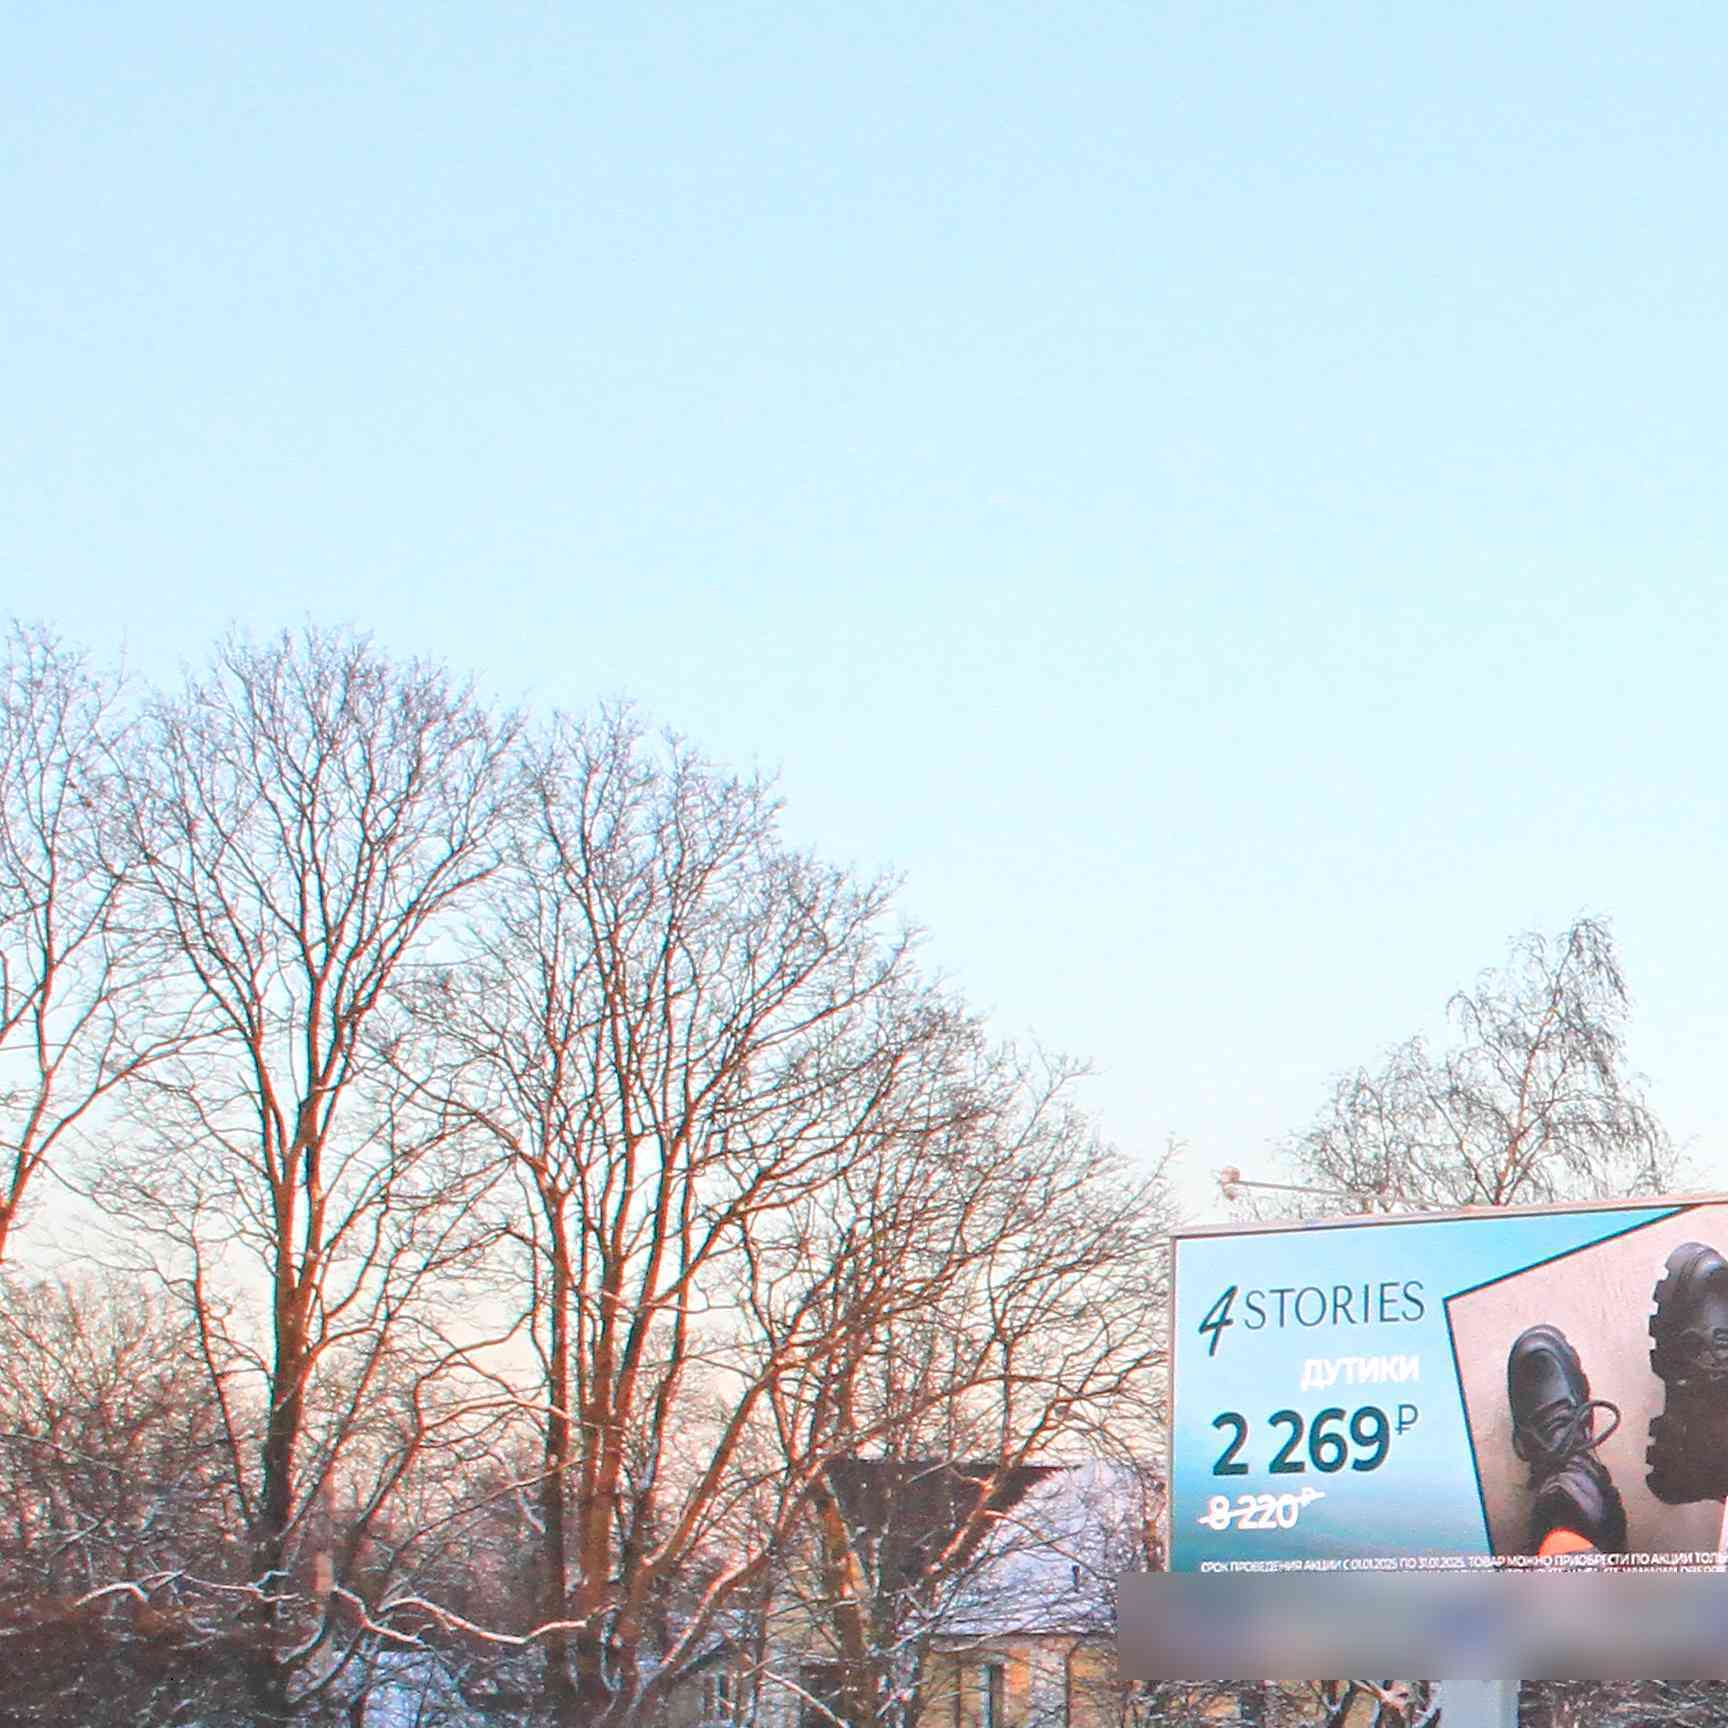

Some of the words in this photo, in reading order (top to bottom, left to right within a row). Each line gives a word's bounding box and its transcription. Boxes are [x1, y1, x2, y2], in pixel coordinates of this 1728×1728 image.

[1300, 1355, 1420, 1391] ДУТИКИ
[1200, 1560, 1228, 1572] СРОК
[1230, 1559, 1302, 1572] ПРОВЕДЕНИЯ
[1303, 1558, 1341, 1571] АКЦИИ
[1400, 1557, 1417, 1569] ПО
[1469, 1555, 1505, 1567] ТОВАР
[1506, 1554, 1553, 1567] МОЖНО
[1555, 1552, 1630, 1567] ПРИОБРЕСТИ
[1631, 1552, 1649, 1565] ПО
[1650, 1552, 1693, 1565] АКЦИИ
